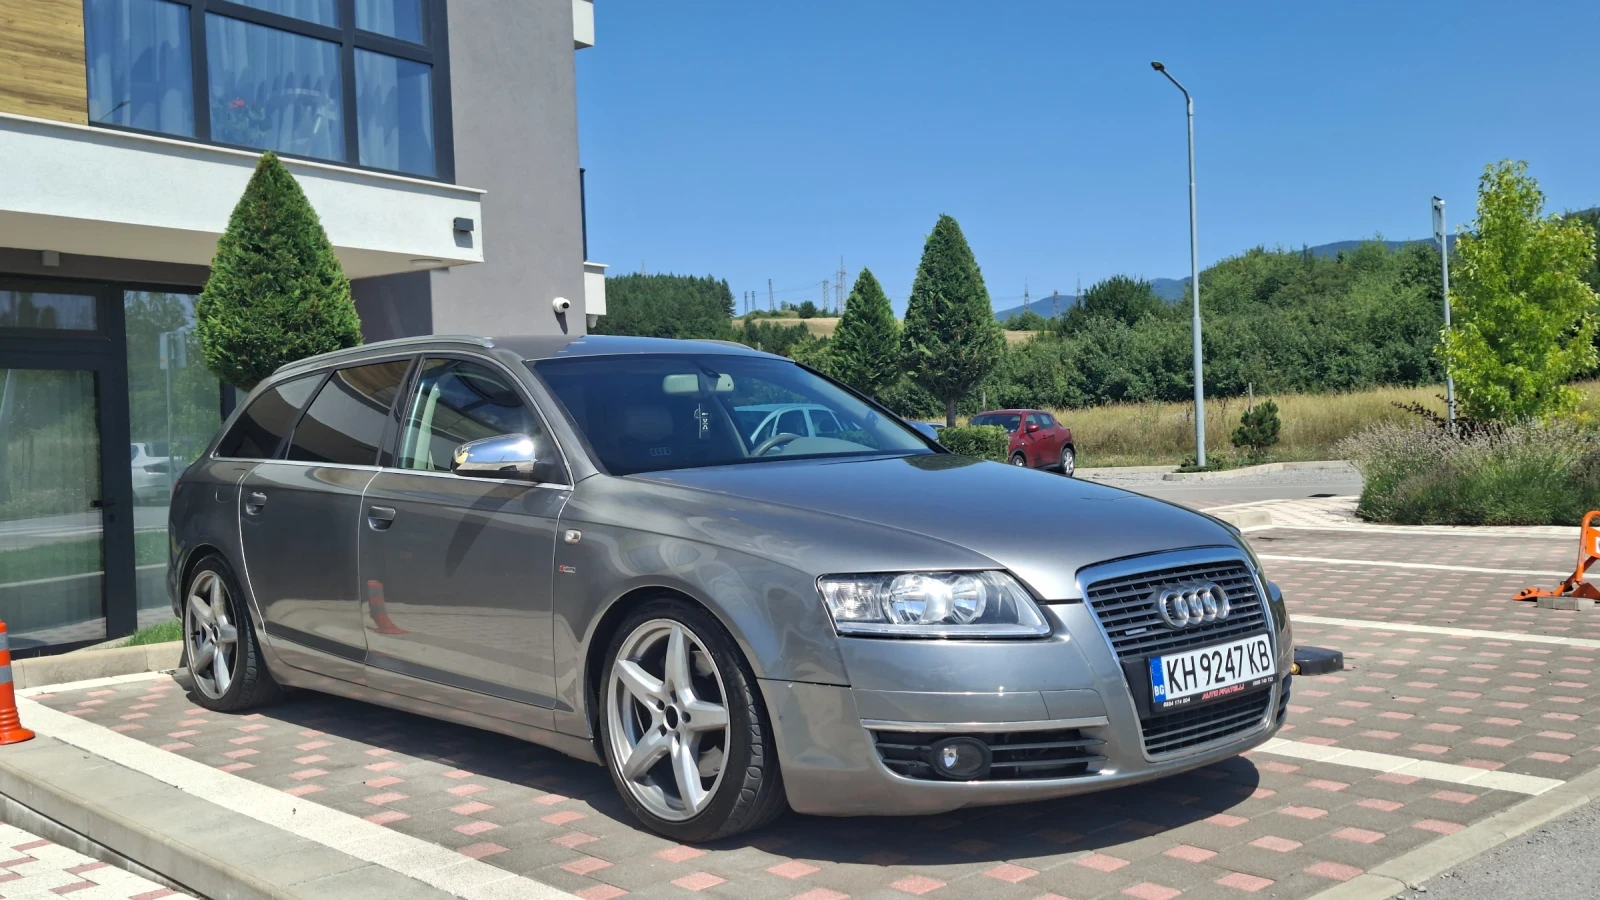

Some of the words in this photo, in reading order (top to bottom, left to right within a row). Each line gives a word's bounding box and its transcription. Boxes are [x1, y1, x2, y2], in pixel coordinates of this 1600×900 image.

[1166, 655, 1198, 694] KH
[1200, 645, 1244, 686] 9247
[1247, 640, 1270, 675] KB
[1154, 684, 1165, 696] BG
[1201, 689, 1219, 700] AUTO
